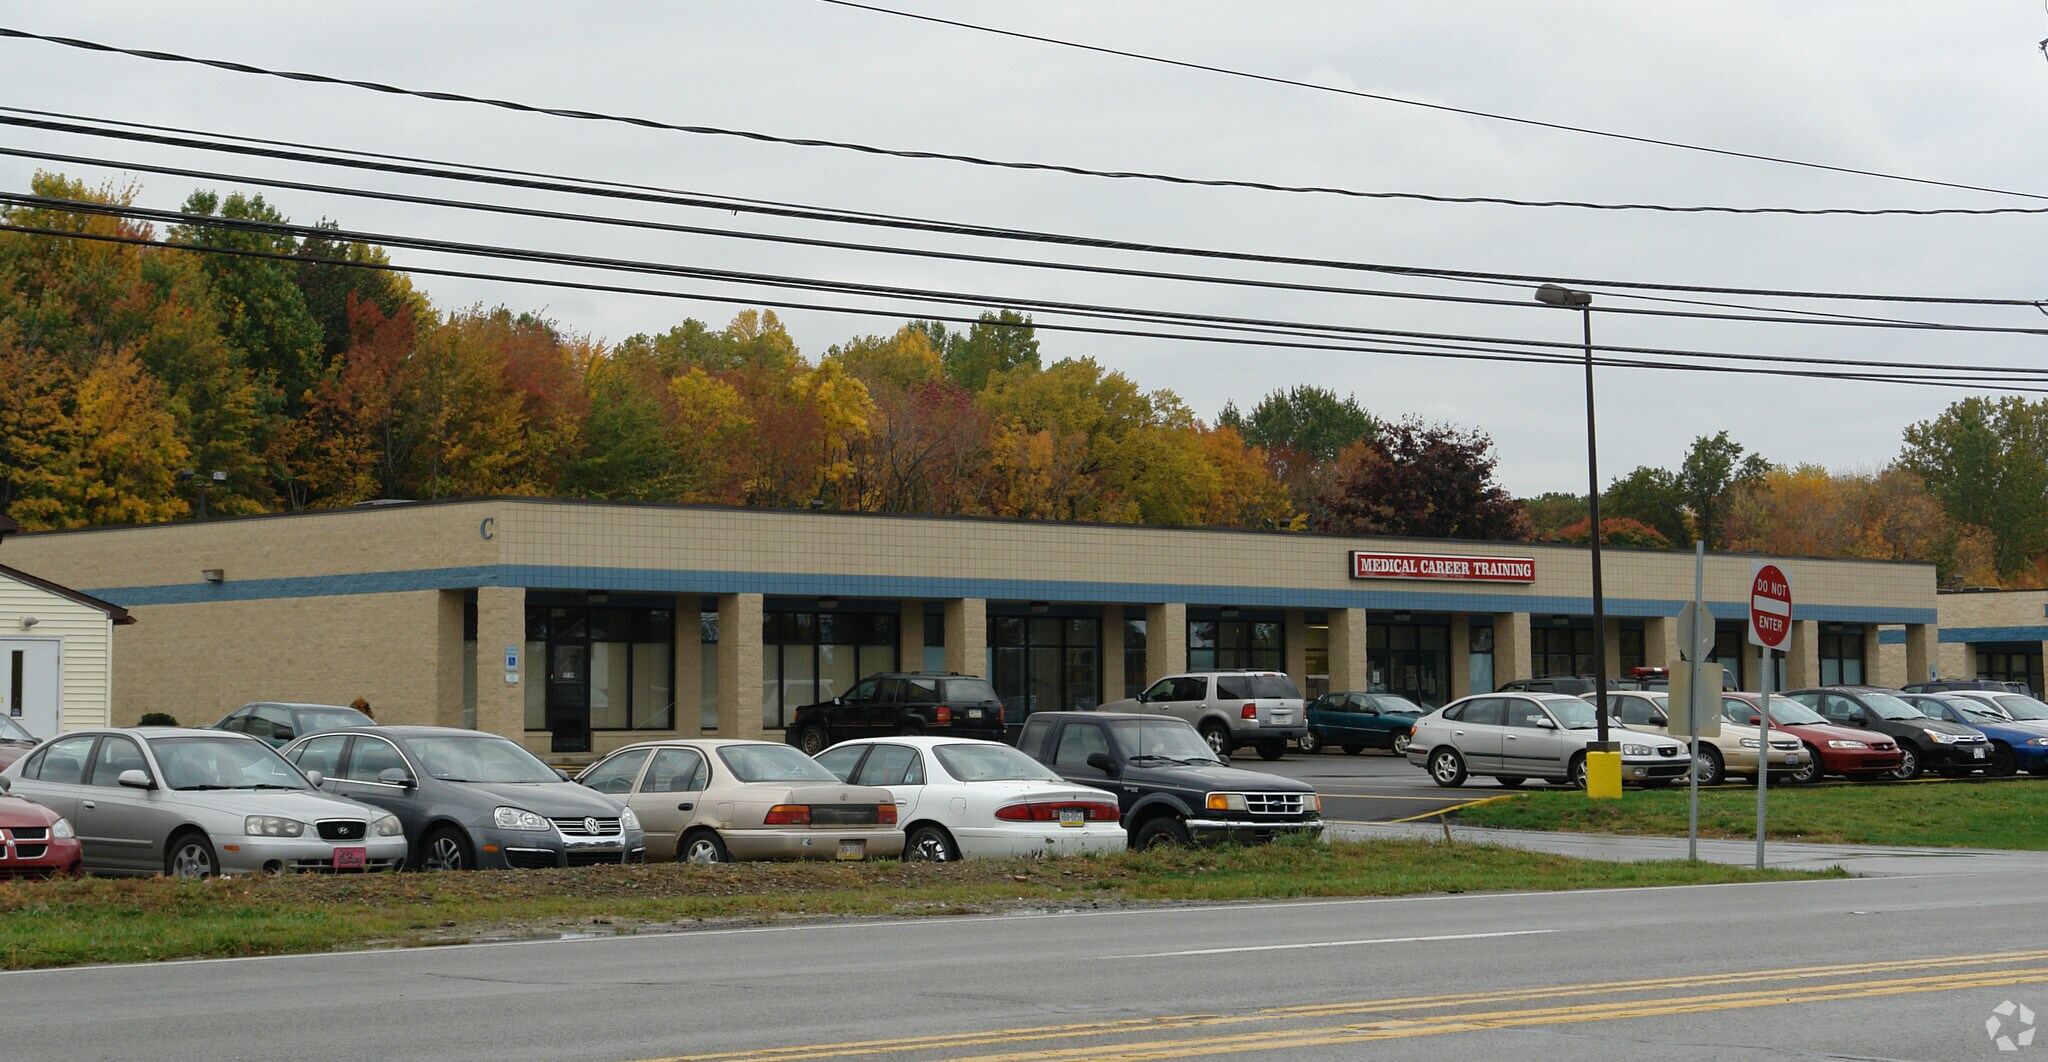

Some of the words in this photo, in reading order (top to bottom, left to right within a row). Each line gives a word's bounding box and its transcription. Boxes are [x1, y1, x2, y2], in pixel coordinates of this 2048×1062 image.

[480, 517, 494, 540] C
[1360, 558, 1418, 573] MEDICAL
[1420, 560, 1470, 575] CAREER
[1473, 562, 1532, 577] TRAINING
[1757, 578, 1768, 592] DO
[1771, 581, 1787, 597] NOT
[1759, 615, 1783, 632] ENTER
